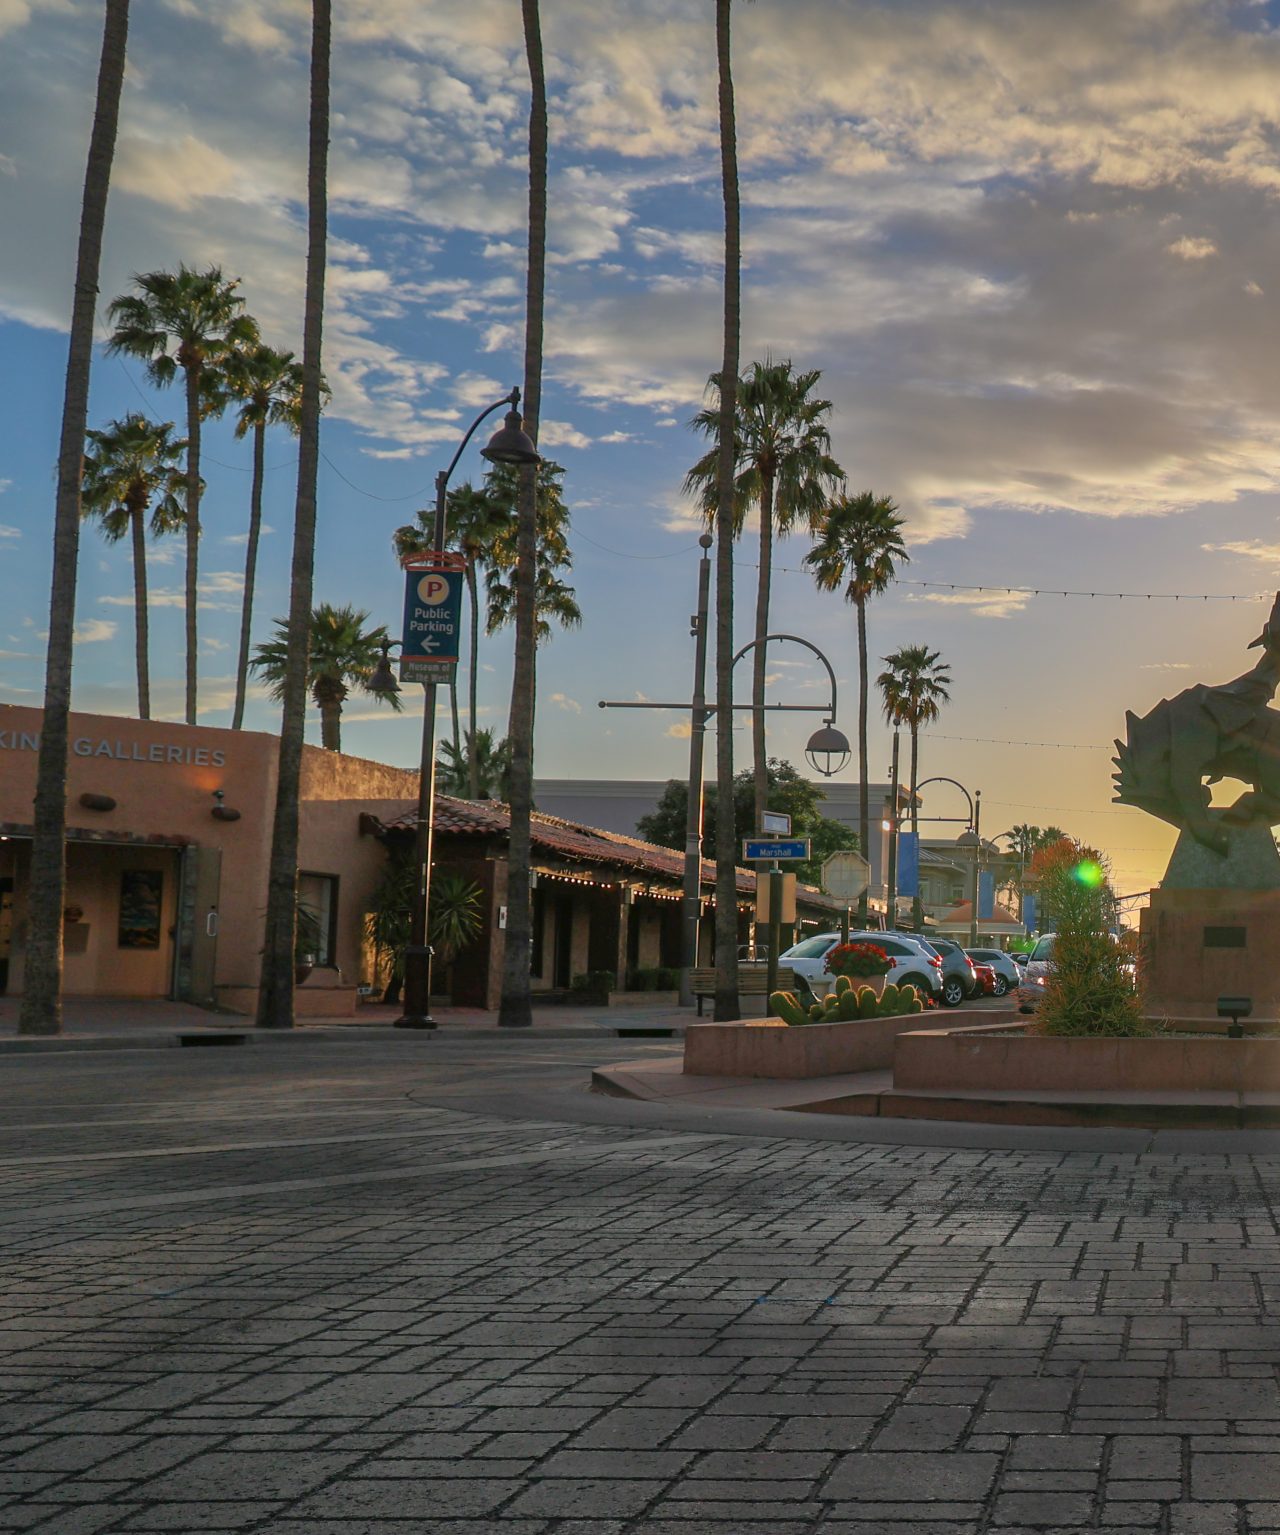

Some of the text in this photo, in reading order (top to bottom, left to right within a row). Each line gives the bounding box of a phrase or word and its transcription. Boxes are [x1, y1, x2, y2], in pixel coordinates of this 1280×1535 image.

[426, 581, 443, 598] P
[414, 607, 451, 620] Public
[409, 620, 454, 635] Parking
[0, 730, 226, 768] KIN GALLERIES
[759, 848, 792, 857] Marshall
